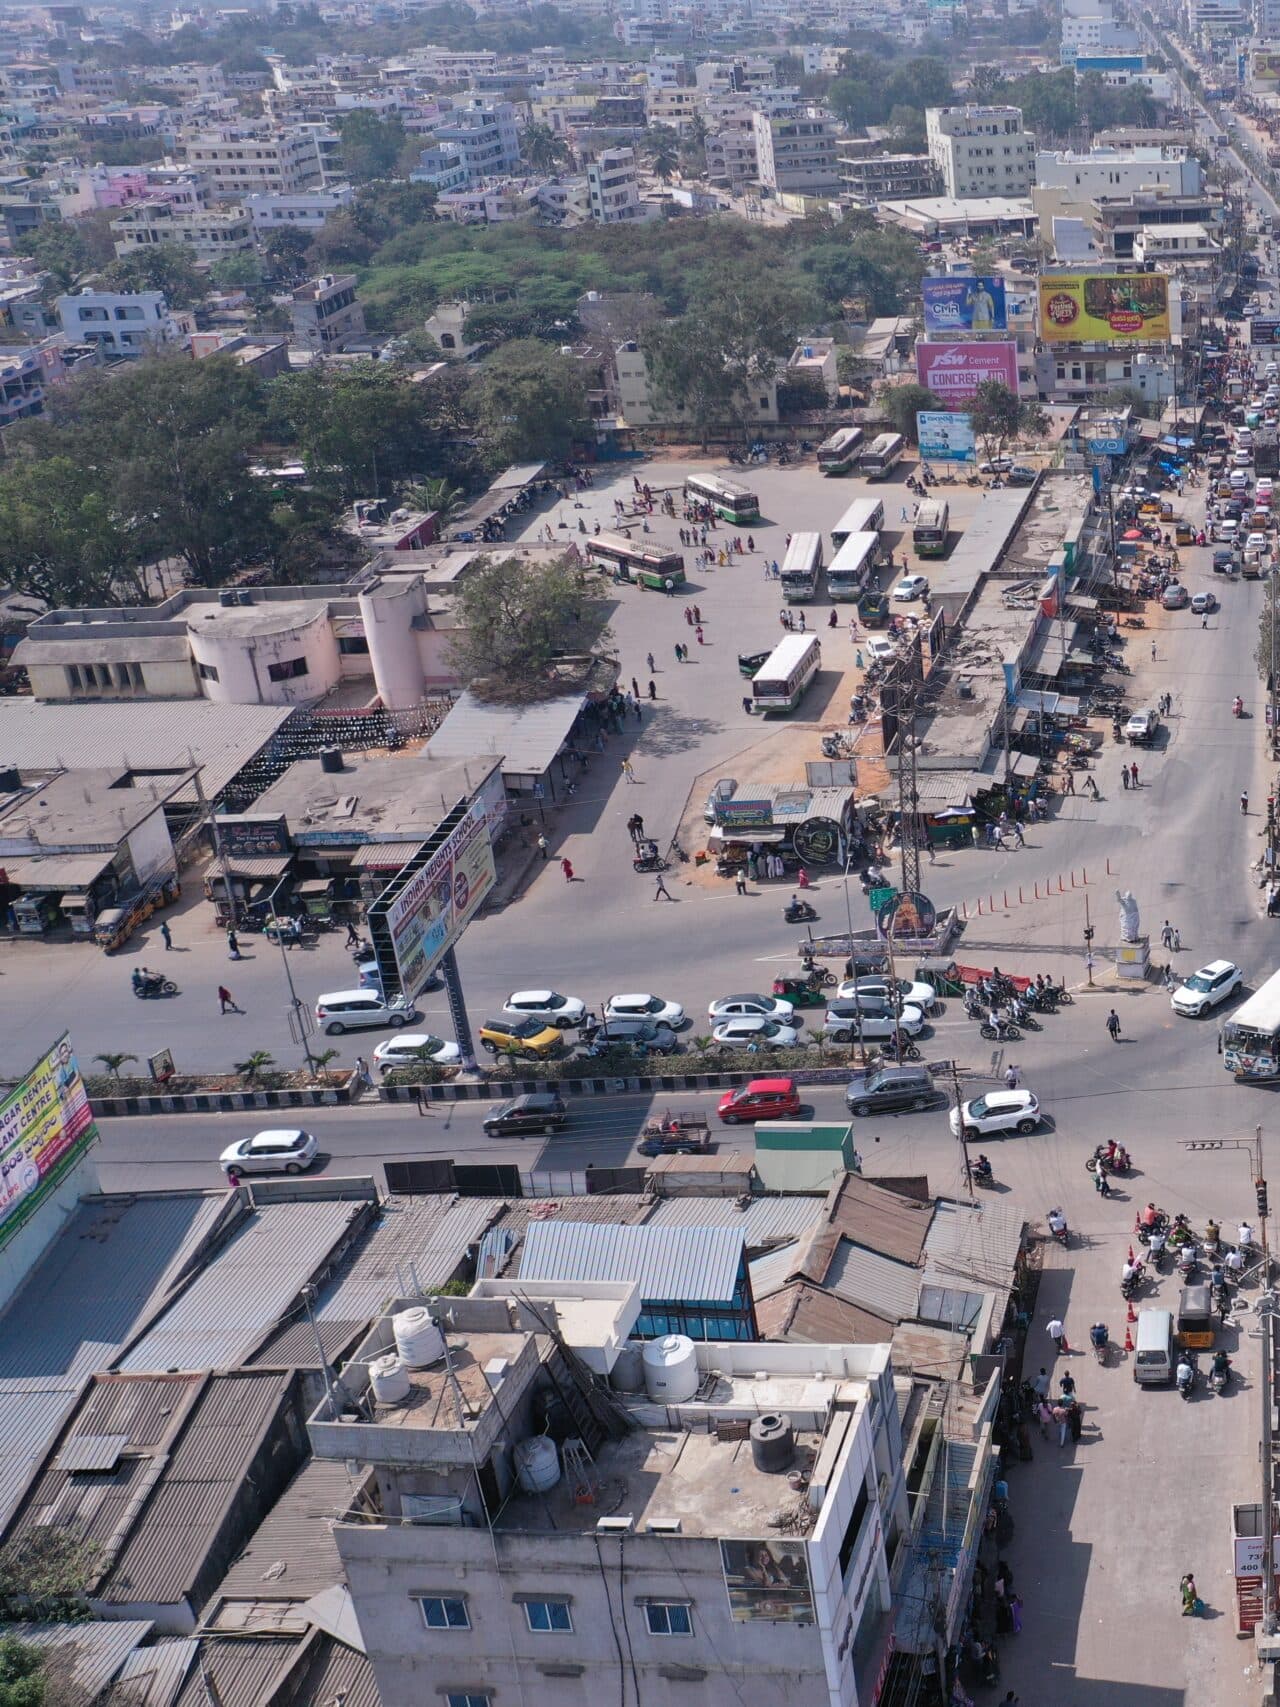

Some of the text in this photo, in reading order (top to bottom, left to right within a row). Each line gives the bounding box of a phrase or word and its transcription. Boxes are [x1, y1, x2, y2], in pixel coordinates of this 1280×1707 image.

[932, 302, 960, 314] CMR
[929, 350, 1000, 368] JSW Cement
[401, 813, 475, 912] INDIAN HEIGHTS SCHOOL
[23, 1072, 53, 1108] DENTAL
[21, 1090, 52, 1127] CENTRE
